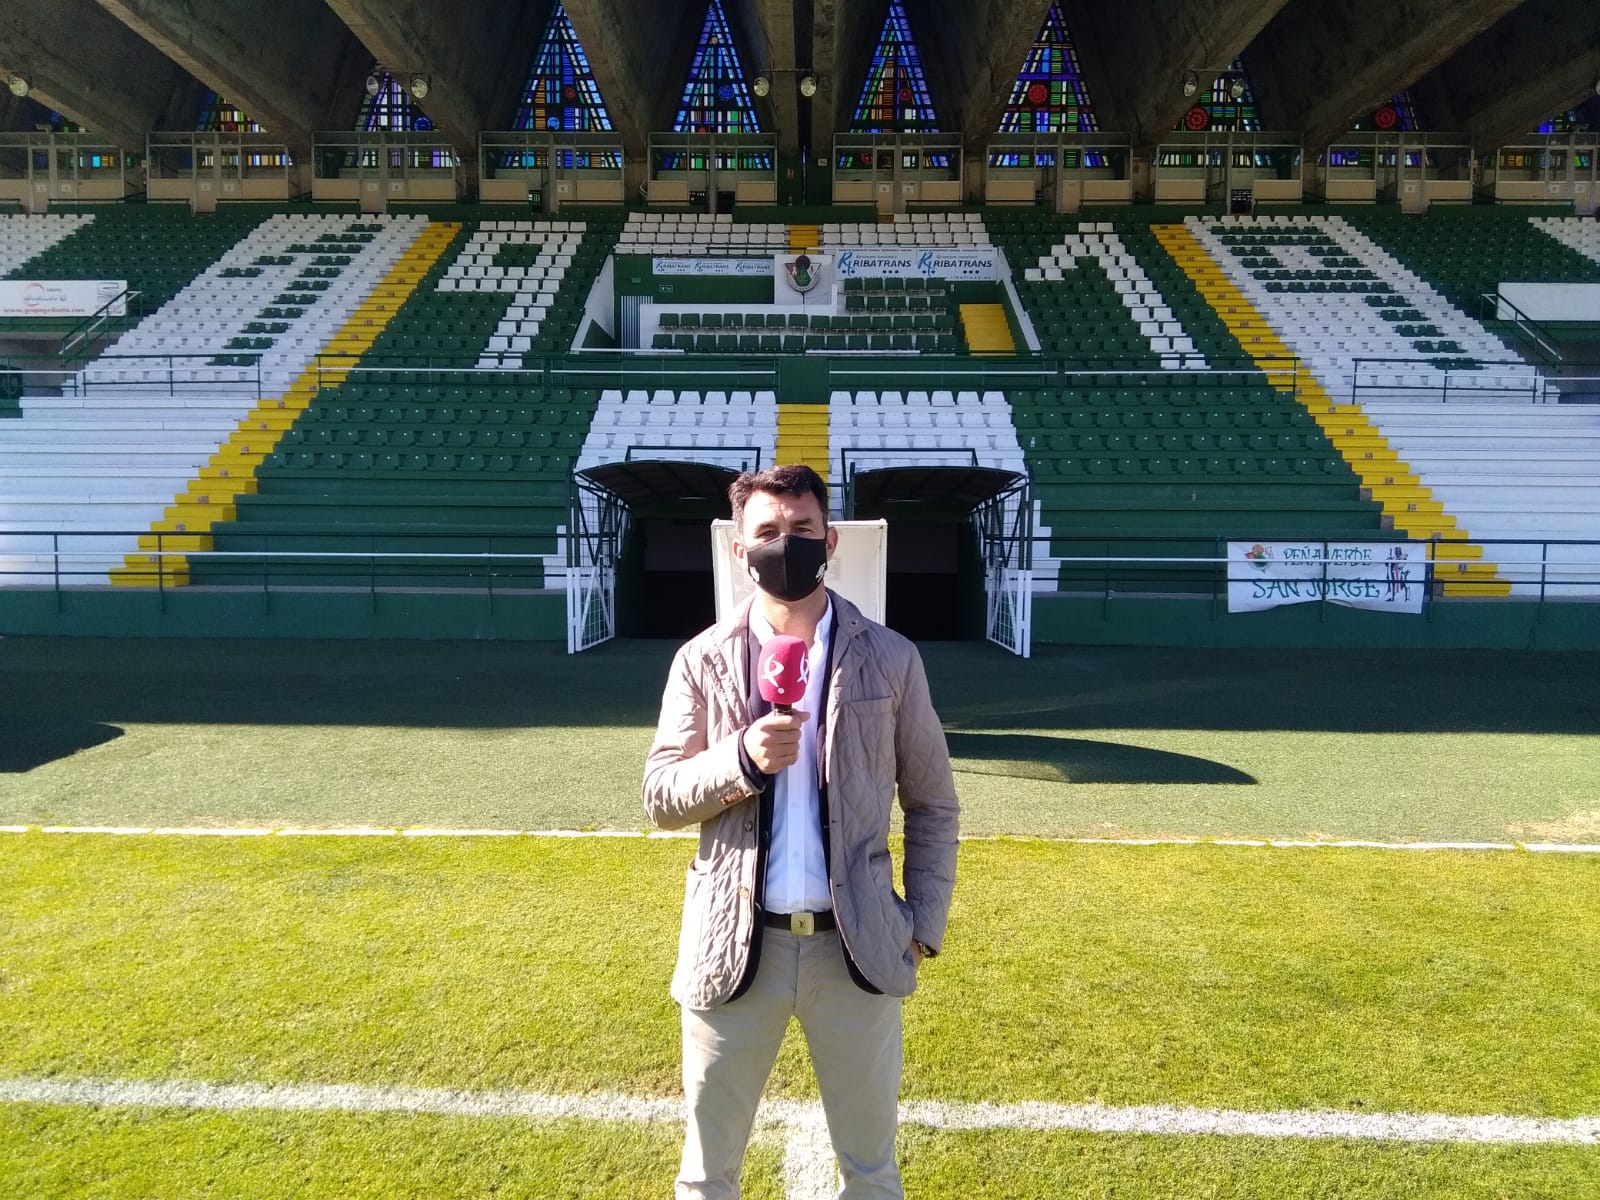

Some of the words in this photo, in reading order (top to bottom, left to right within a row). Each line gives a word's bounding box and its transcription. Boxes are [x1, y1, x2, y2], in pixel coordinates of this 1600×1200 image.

[852, 259, 912, 268] RIBATRANS
[932, 259, 993, 268] RIBATRANS
[1283, 546, 1323, 566] PEÑA
[1327, 546, 1373, 566] VERDE
[1253, 578, 1301, 599] SAN
[1306, 577, 1380, 598] JORGE
